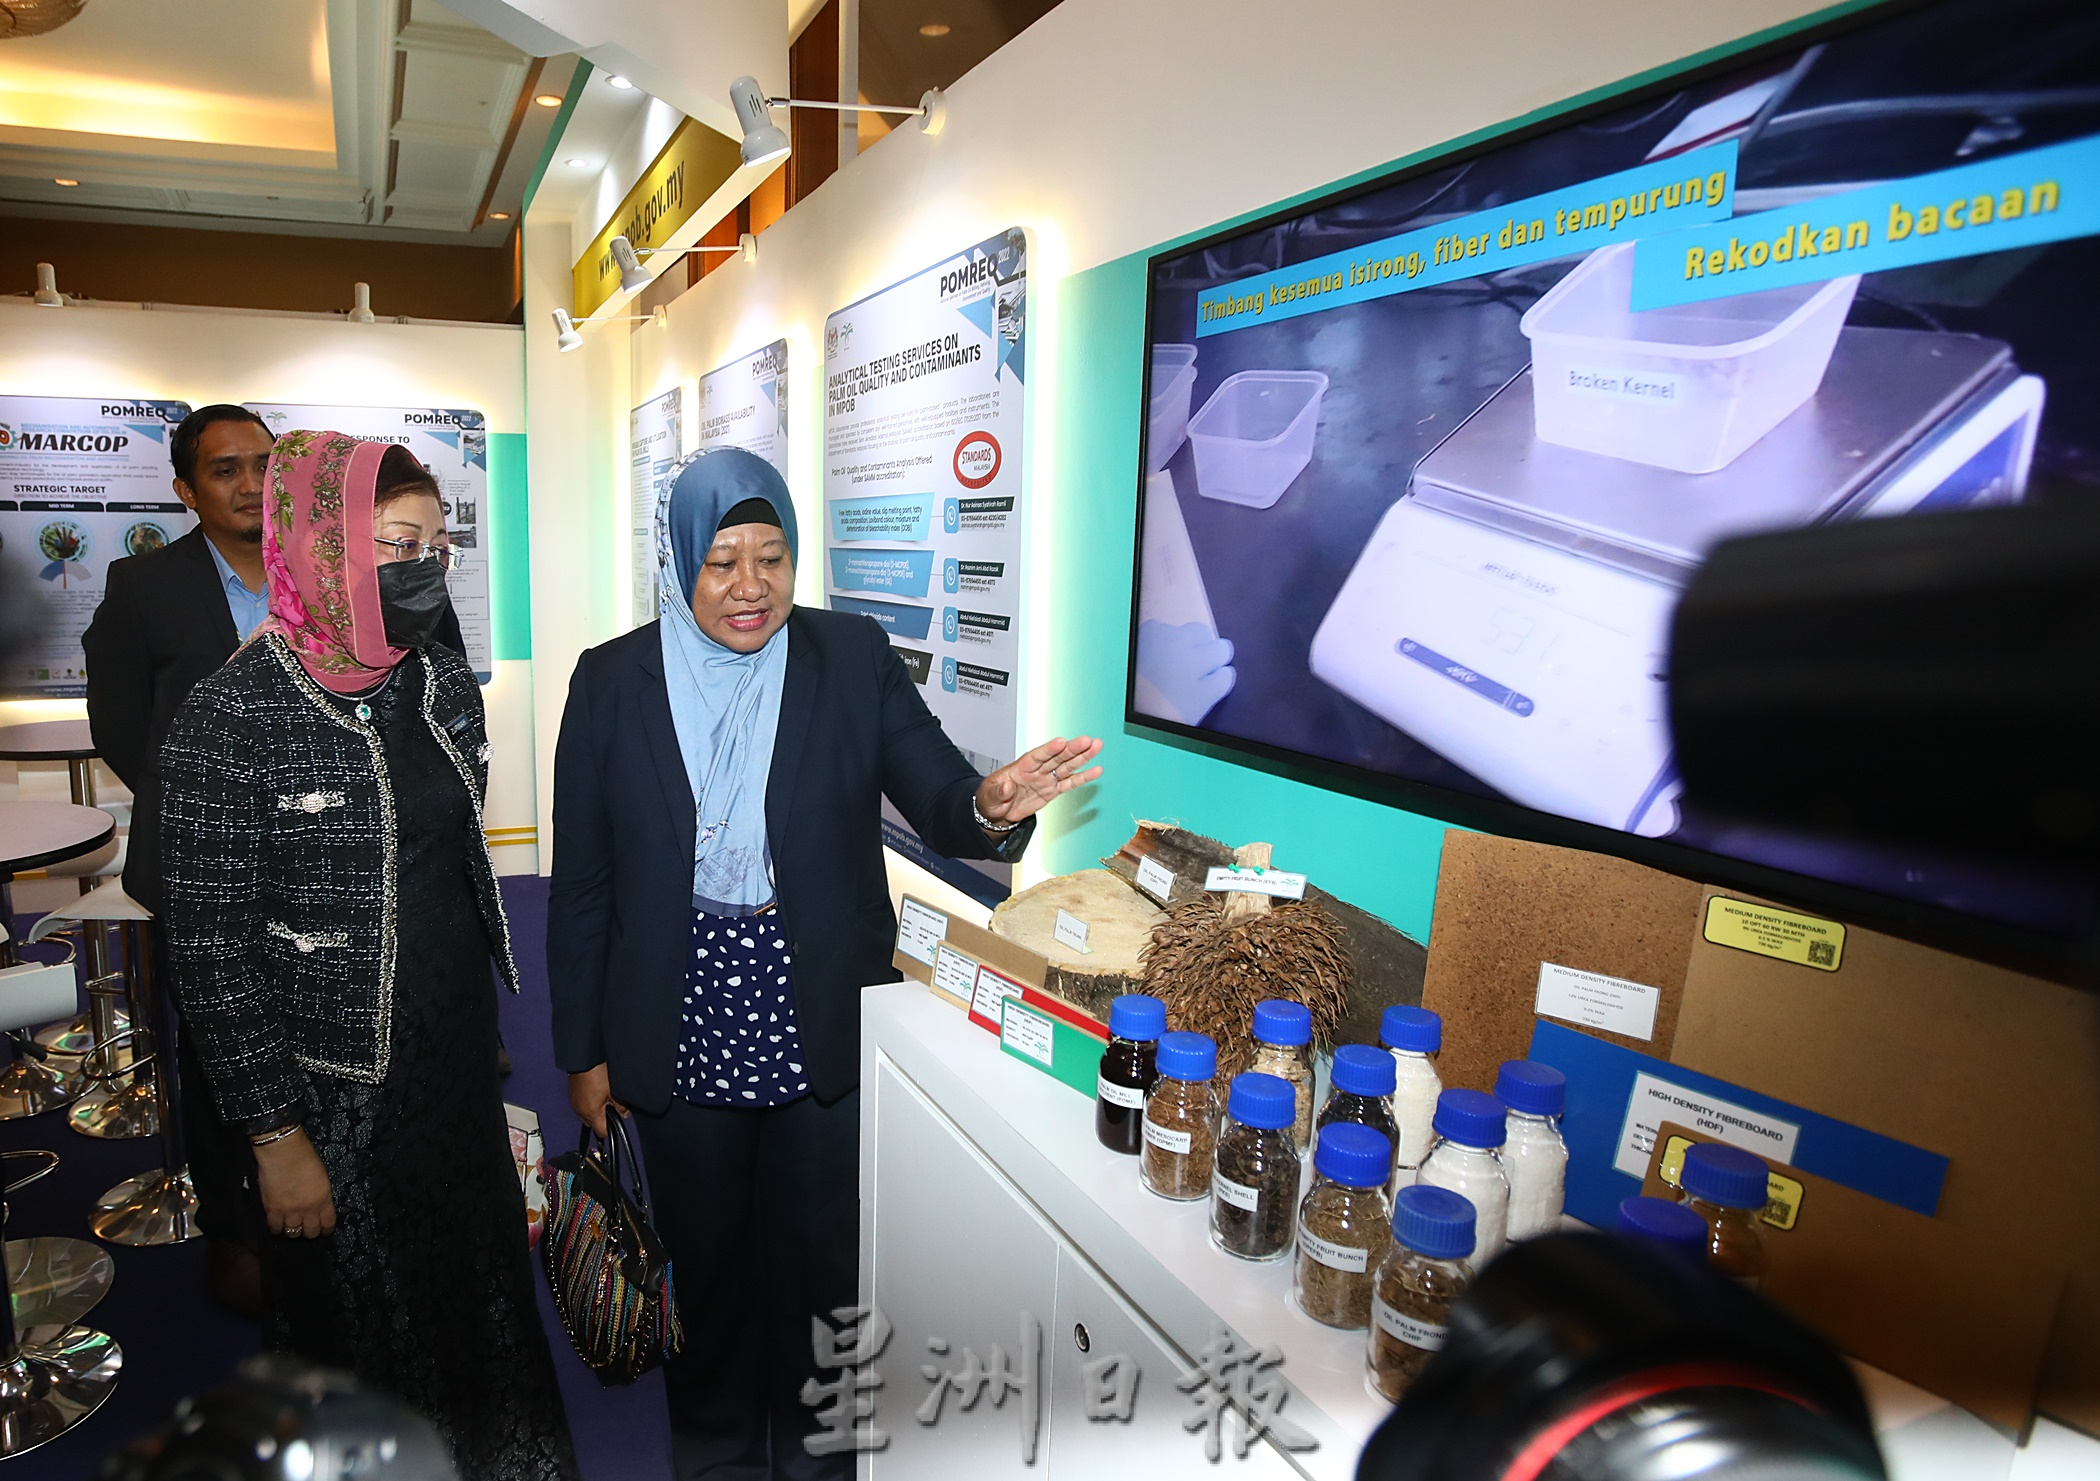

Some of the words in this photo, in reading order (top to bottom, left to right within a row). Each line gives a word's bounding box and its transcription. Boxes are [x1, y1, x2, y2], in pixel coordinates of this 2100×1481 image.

[599, 160, 685, 281] wwwpob.gov.my
[1684, 219, 1869, 280] Rekodkan
[1886, 180, 2061, 243] bacaan
[1201, 290, 1264, 323] Timbang
[1269, 271, 1343, 307] kesemua
[1349, 250, 1426, 287] isirong,
[1433, 230, 1490, 266] fiber
[1498, 217, 1545, 250] dan
[1554, 171, 1726, 231] tempurung
[940, 253, 998, 297] POMREQ
[829, 364, 868, 389] ANALYTICAL
[869, 355, 900, 378] TESTING
[902, 338, 942, 366] SERVICES
[944, 332, 958, 351] ON
[828, 385, 846, 403] PALM
[846, 381, 858, 398] OIL
[858, 373, 890, 396] QUALITY
[890, 368, 908, 386] AND
[908, 344, 982, 380] CONTAMINANTS
[1568, 370, 1618, 392] Broken
[1621, 376, 1676, 400] Kernel
[101, 405, 166, 418] POMREQ
[828, 404, 836, 418] IN
[836, 398, 856, 416] MPOB
[404, 414, 461, 425] POMREQ
[20, 432, 129, 452] MARCOP
[351, 435, 395, 444] SPONSE
[397, 436, 410, 444] TO
[962, 448, 992, 464] STANDARDS
[832, 468, 840, 476] Palm
[846, 464, 860, 476] Quality
[868, 458, 896, 472] Contaminants
[896, 456, 914, 470] Analysis
[915, 454, 932, 465] Offered
[974, 464, 991, 472] MALAYSIA
[864, 473, 876, 482] SAMM
[14, 484, 67, 493] STRATEGIC
[70, 485, 106, 493] TARGET
[888, 507, 902, 516] melting
[902, 506, 912, 515] point,
[912, 506, 922, 515] fatty
[882, 614, 896, 623] content
[912, 656, 920, 668] (Fe)
[1724, 906, 1753, 918] MEDIUM
[1754, 913, 1782, 925] DENSITY
[1783, 920, 1827, 935] FIBREBOARD
[1554, 968, 1580, 979] MEDIUM
[1580, 974, 1606, 985] DENSITY
[1607, 980, 1646, 994] FIBREBOARD
[1594, 989, 1609, 997] FROND
[1648, 1088, 1672, 1103] HIGH
[1673, 1097, 1715, 1117] DENSITY
[1716, 1111, 1783, 1142] FIBREBOARD
[1697, 1118, 1724, 1135] (HDF)
[1156, 1132, 1188, 1142] MESOCARP
[1234, 1189, 1254, 1200] SHELL
[1317, 1244, 1335, 1256] FRUIT
[1337, 1252, 1364, 1261] BUNCH
[1384, 1312, 1393, 1322] OIL
[1395, 1319, 1417, 1334] PALM
[1418, 1328, 1448, 1340] FROND
[1402, 1331, 1422, 1342] CHIP
